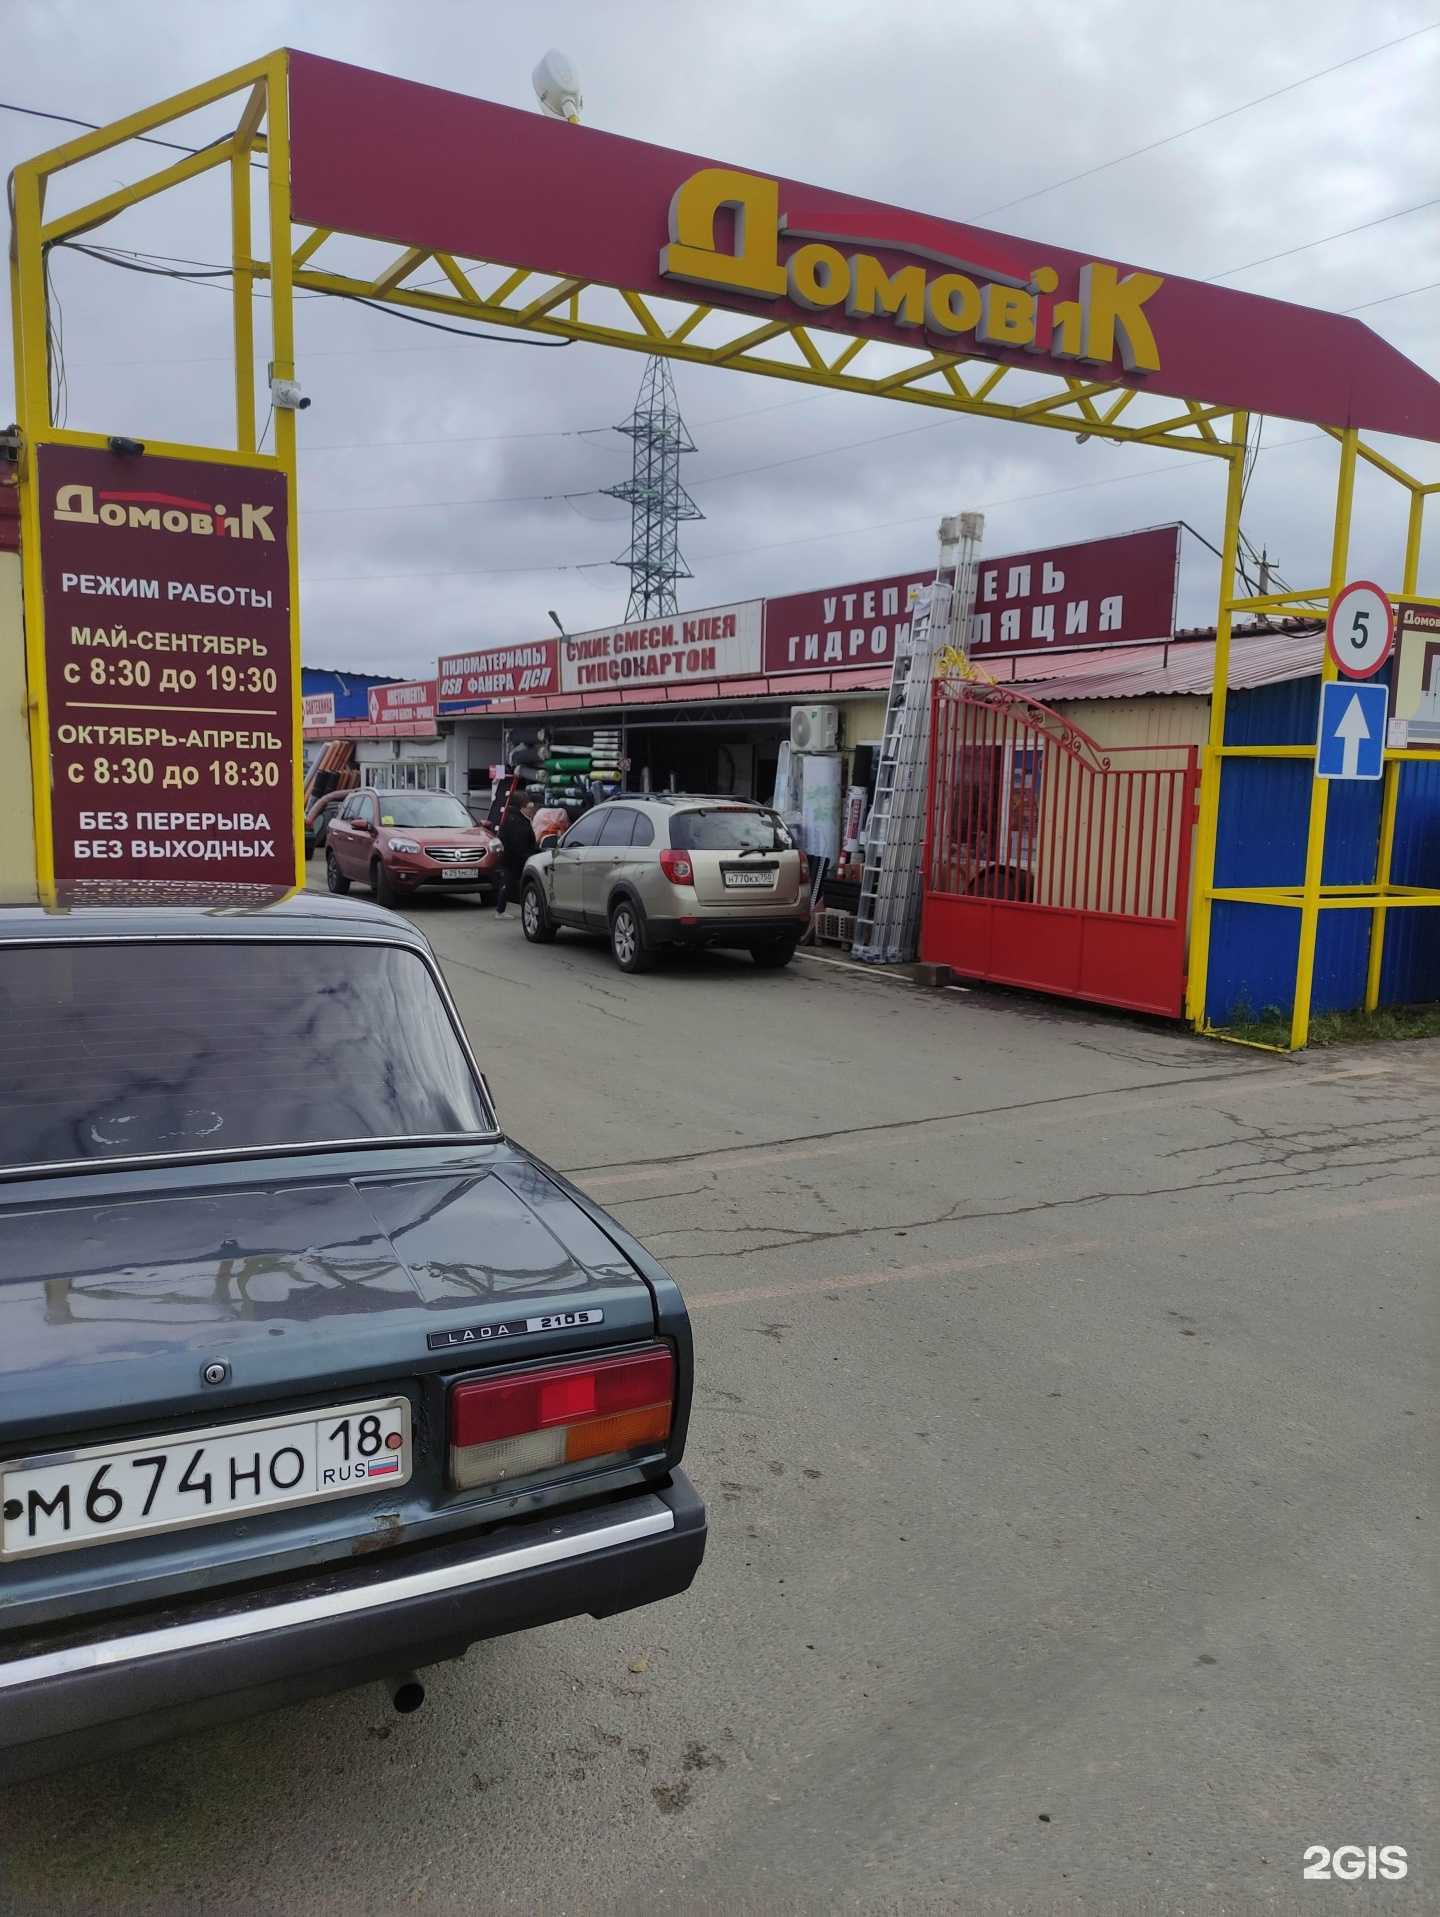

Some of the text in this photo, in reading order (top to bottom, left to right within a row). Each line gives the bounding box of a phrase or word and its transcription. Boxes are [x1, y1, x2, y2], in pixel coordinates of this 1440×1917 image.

[62, 573, 272, 608] РЕЖИМ РАБОТЫ
[823, 561, 1065, 624] УТЕПЛЕЛЬ
[71, 624, 267, 656] МАЙ-СЕНТЯБРЬ
[567, 636, 610, 662] СУХИЕ
[682, 614, 736, 644] КЛЕЯ
[788, 595, 1123, 662] ГИДРОИЛЯЦИЯ
[1350, 611, 1369, 649] 5
[64, 659, 277, 694] с 8:30 до 19:30
[442, 645, 546, 676] ПИЛОМАТЕРИАЛЫ
[577, 647, 716, 685] ГИПСОКАРТОН
[441, 667, 552, 695] OSB ФАНЕРА ДСП
[58, 724, 282, 749] ОКТЯБРЬ-АПРЕЛЬ
[68, 757, 279, 789] с 8:30 до 18:30
[79, 811, 270, 831] БЕЗ ПЕРЕРЫВА
[74, 839, 275, 861] БЕЗ ВЫХОДНЫХ
[448, 1313, 589, 1343] LADA 2105
[28, 1415, 382, 1536] М674НО 18
[323, 1463, 366, 1485] RUS
